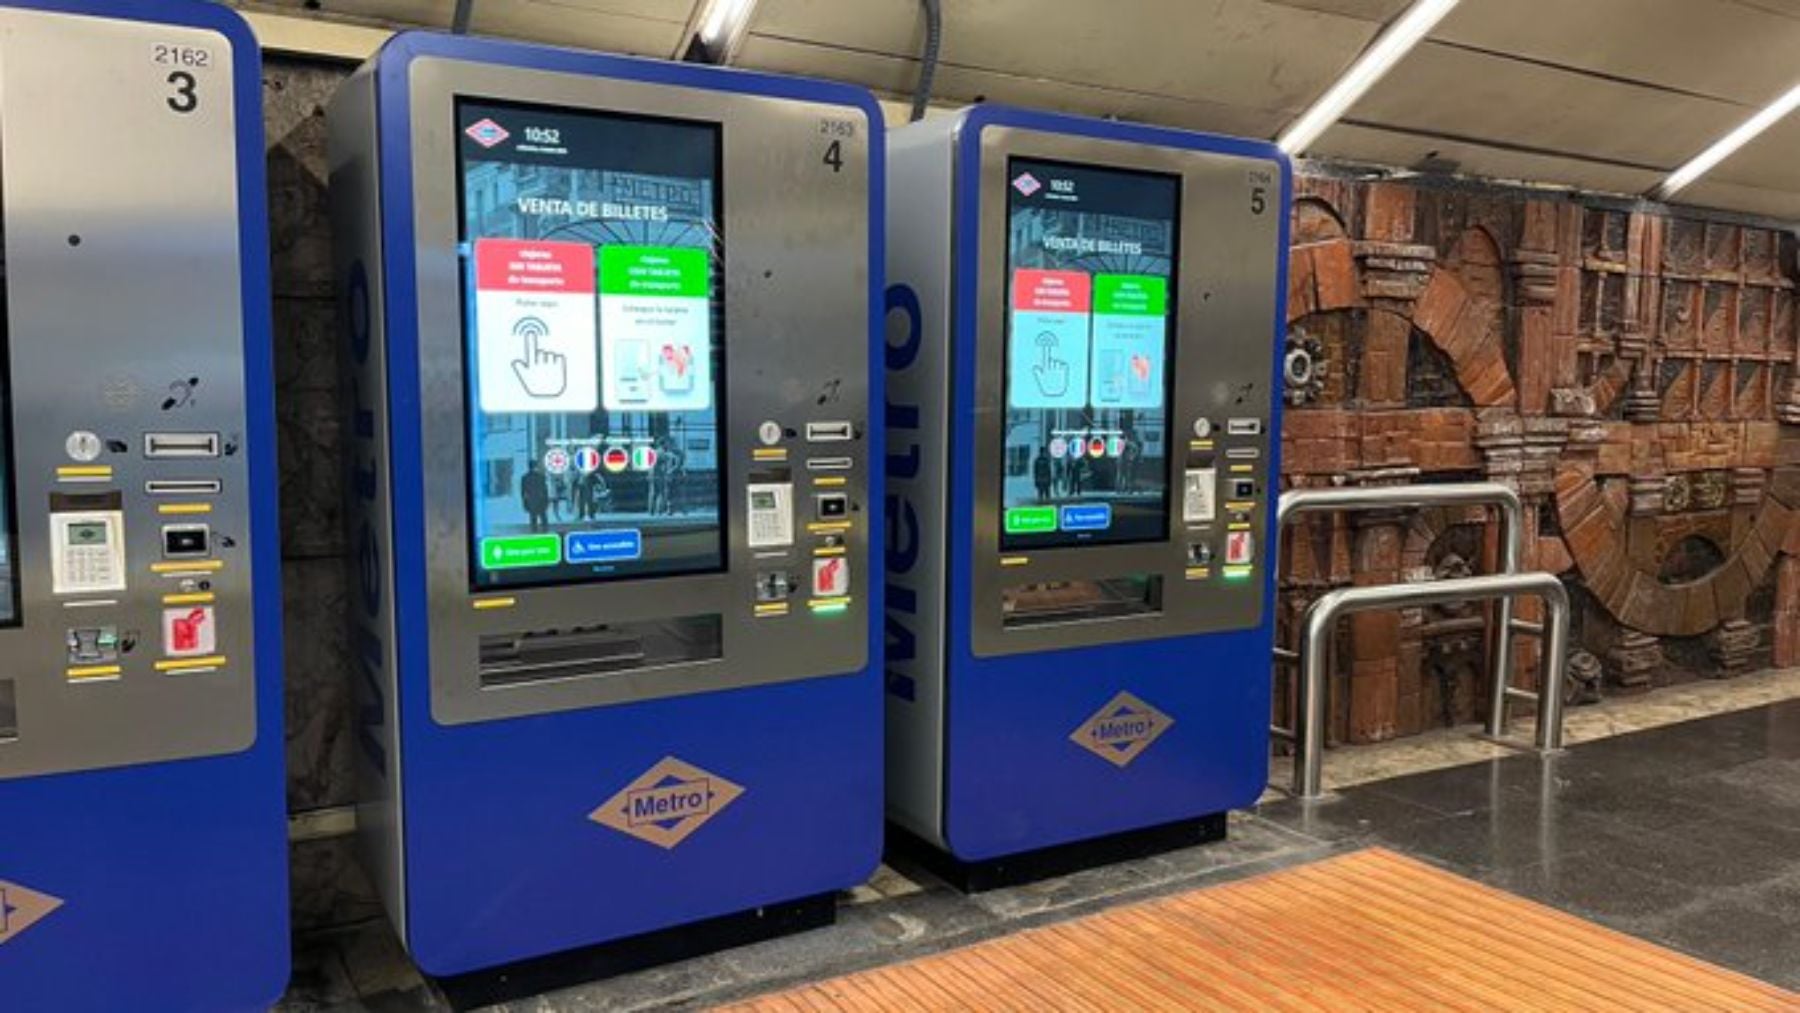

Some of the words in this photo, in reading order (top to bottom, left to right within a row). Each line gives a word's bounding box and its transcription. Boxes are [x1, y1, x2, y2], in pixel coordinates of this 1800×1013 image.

[154, 45, 209, 67] 2162
[166, 71, 198, 113] 3
[523, 126, 560, 144] 10:52
[822, 140, 844, 173] 4
[516, 197, 573, 216] VENTA
[575, 200, 599, 218] DE
[601, 202, 669, 221] BILLETES
[1251, 187, 1266, 214] 5
[1042, 234, 1079, 250] VENTA
[1101, 721, 1144, 739] Metro
[634, 791, 703, 818] Metro
